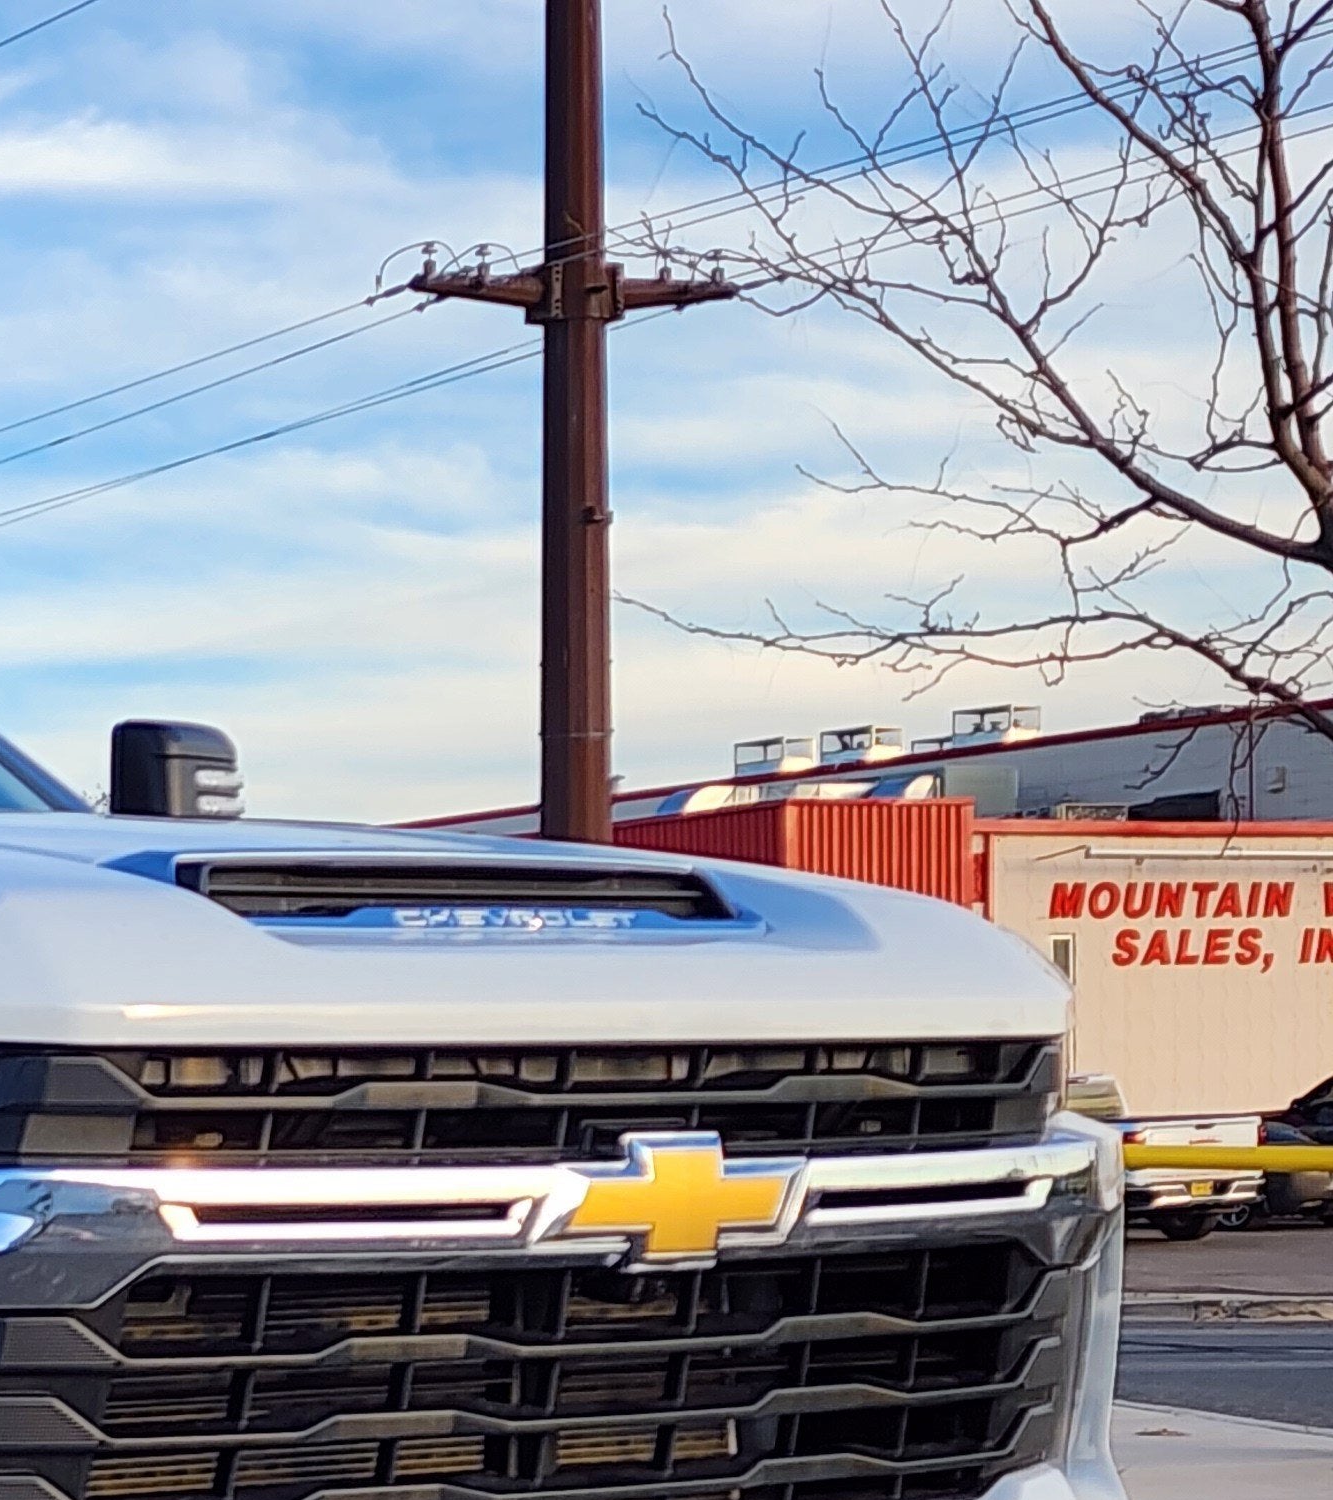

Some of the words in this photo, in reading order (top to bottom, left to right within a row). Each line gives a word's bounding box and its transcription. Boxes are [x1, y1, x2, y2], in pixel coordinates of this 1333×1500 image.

[392, 905, 637, 930] CHEVROLET
[1049, 881, 1295, 919] MOUNTAIN
[1112, 928, 1274, 973] SALES,
